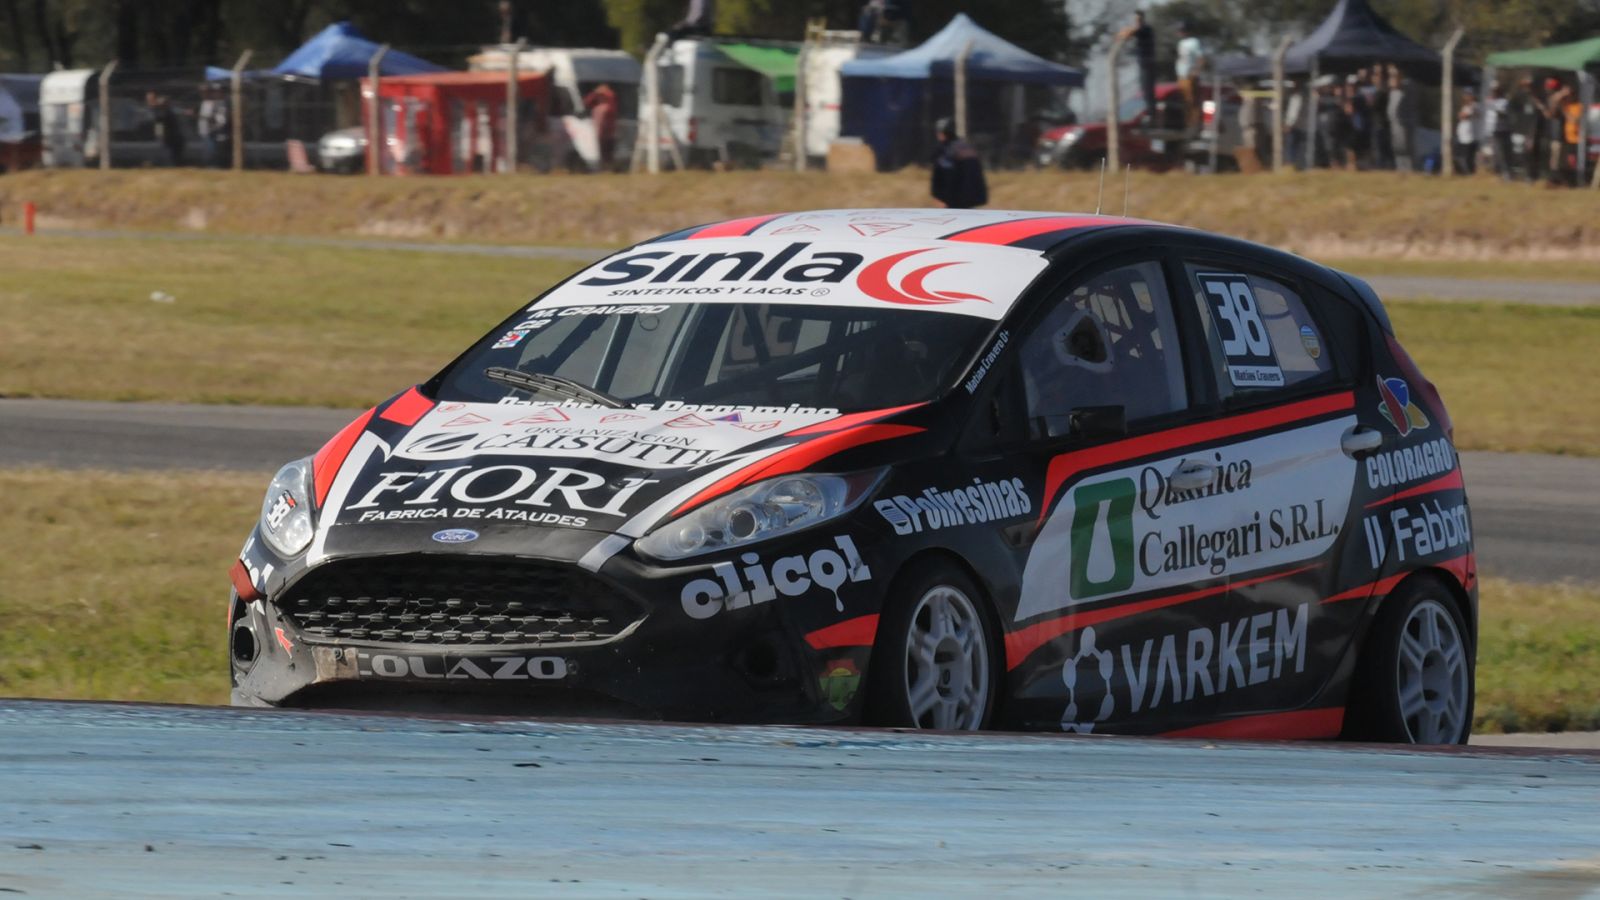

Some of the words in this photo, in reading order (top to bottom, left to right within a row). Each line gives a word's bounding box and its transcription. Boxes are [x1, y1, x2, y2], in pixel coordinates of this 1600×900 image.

[557, 305, 670, 316] CRAVERO
[608, 287, 724, 297] SINTETICOS
[728, 286, 742, 296] Y
[743, 286, 807, 296] LACAS
[1205, 281, 1270, 356] 38
[523, 426, 697, 447] ORGANIZACION
[1366, 437, 1453, 490] COLORAGRO
[266, 495, 290, 529] 38
[345, 465, 659, 517] FIORI
[358, 508, 449, 523] FABRICA
[453, 508, 484, 519] DE
[485, 507, 589, 528] ATAUDES
[1140, 511, 1262, 576] Callegari
[1270, 499, 1339, 551] S.R.L.
[1121, 602, 1310, 713] VARKEM
